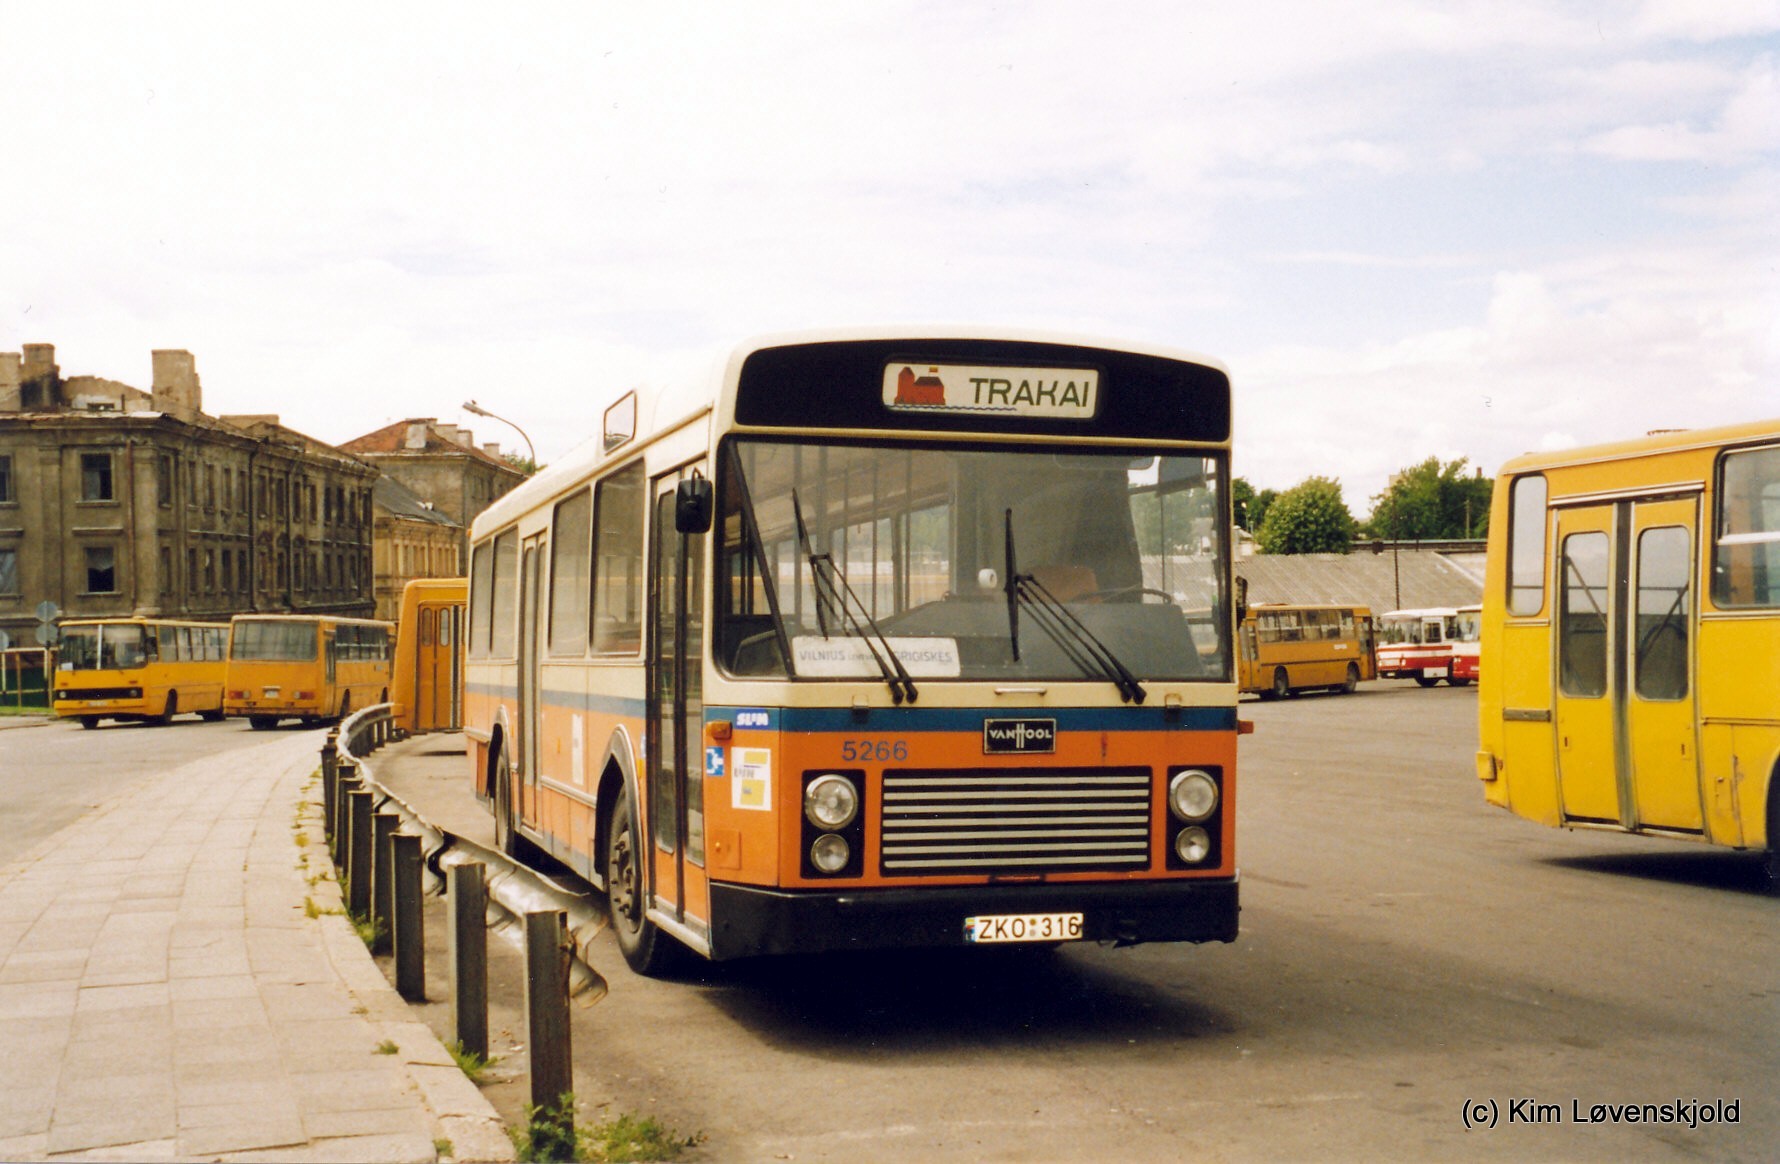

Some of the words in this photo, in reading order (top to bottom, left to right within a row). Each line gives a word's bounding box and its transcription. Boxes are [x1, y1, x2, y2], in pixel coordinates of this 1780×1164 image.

[969, 377, 1089, 408] TRAKAI
[799, 650, 846, 661] VILNIUS
[841, 740, 908, 761] 5266
[978, 918, 1026, 939] ZKO
[1041, 916, 1080, 937] 316
